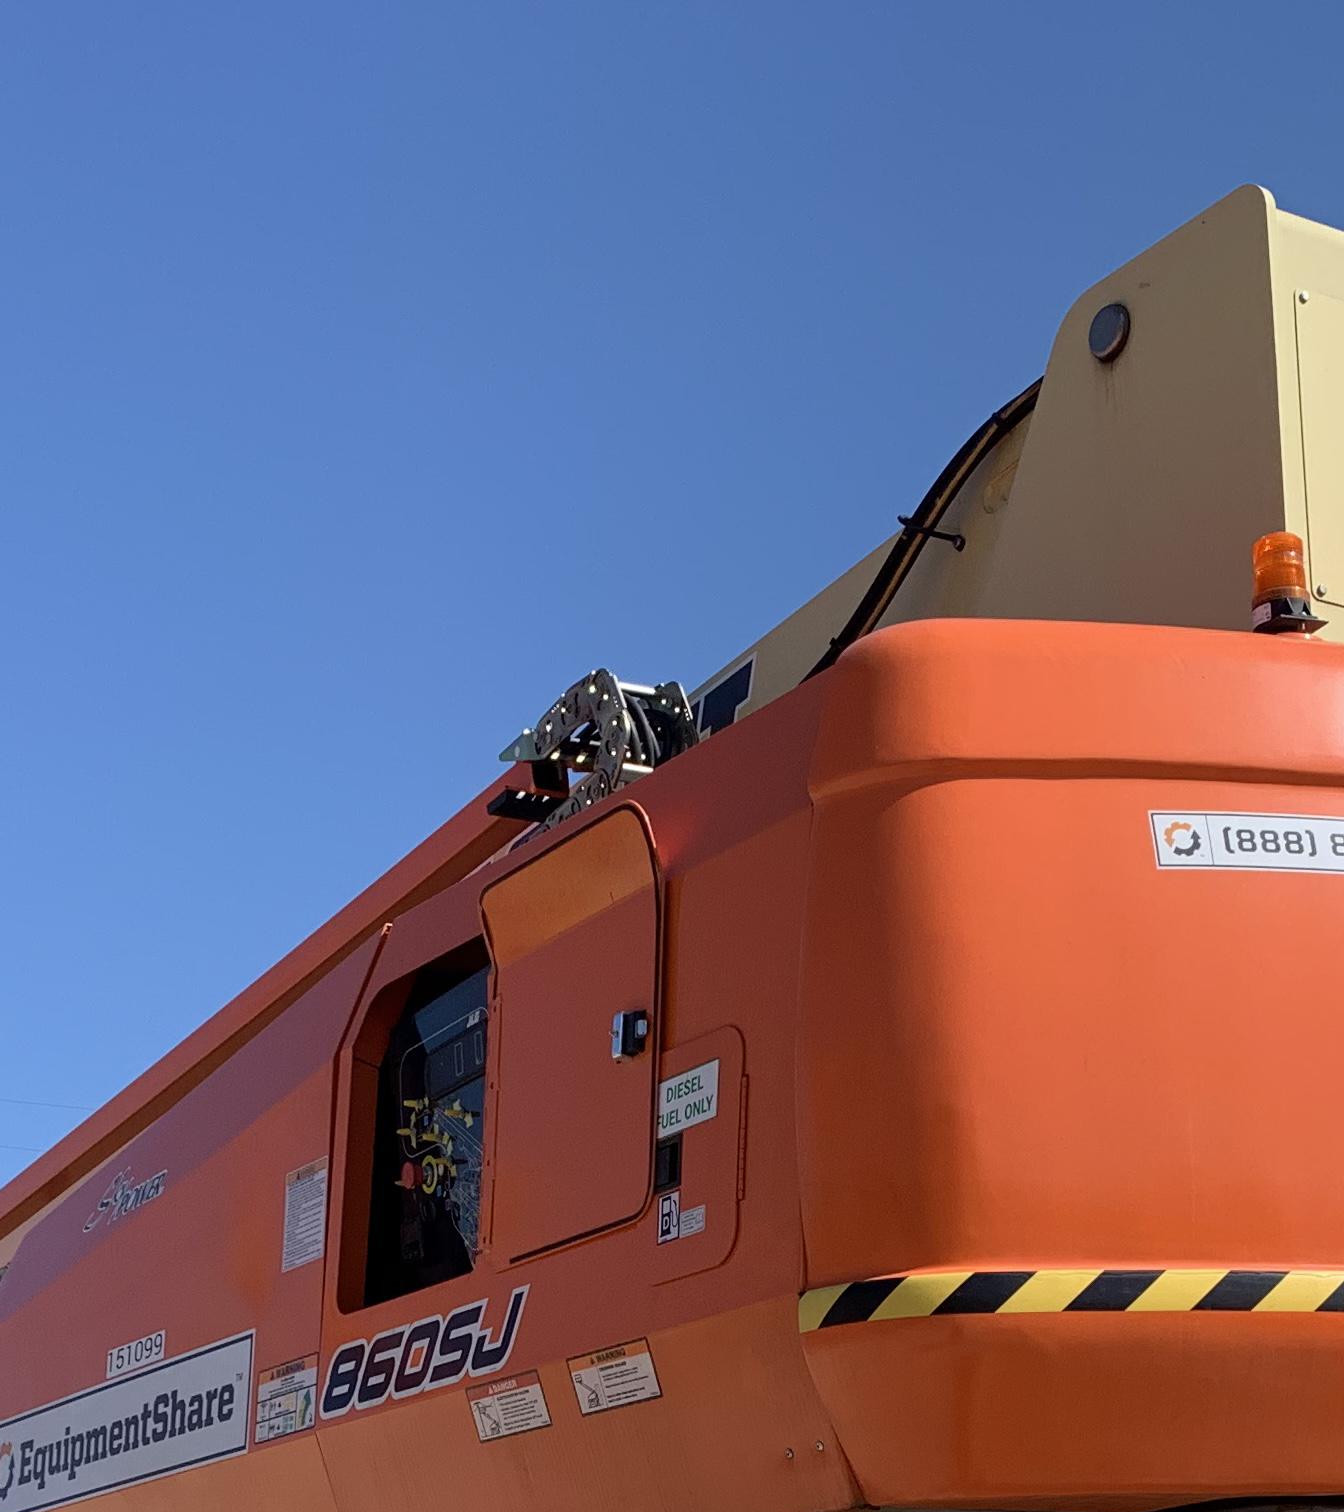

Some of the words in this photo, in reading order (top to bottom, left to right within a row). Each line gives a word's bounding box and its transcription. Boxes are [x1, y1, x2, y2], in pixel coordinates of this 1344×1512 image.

[1222, 826, 1317, 857] (888)
[666, 1075, 704, 1103] DIESEL
[684, 1094, 713, 1120] ONLY
[108, 1333, 164, 1373] 151099
[321, 1285, 530, 1419] 860SJ
[17, 1383, 235, 1490] EquipmentShare
